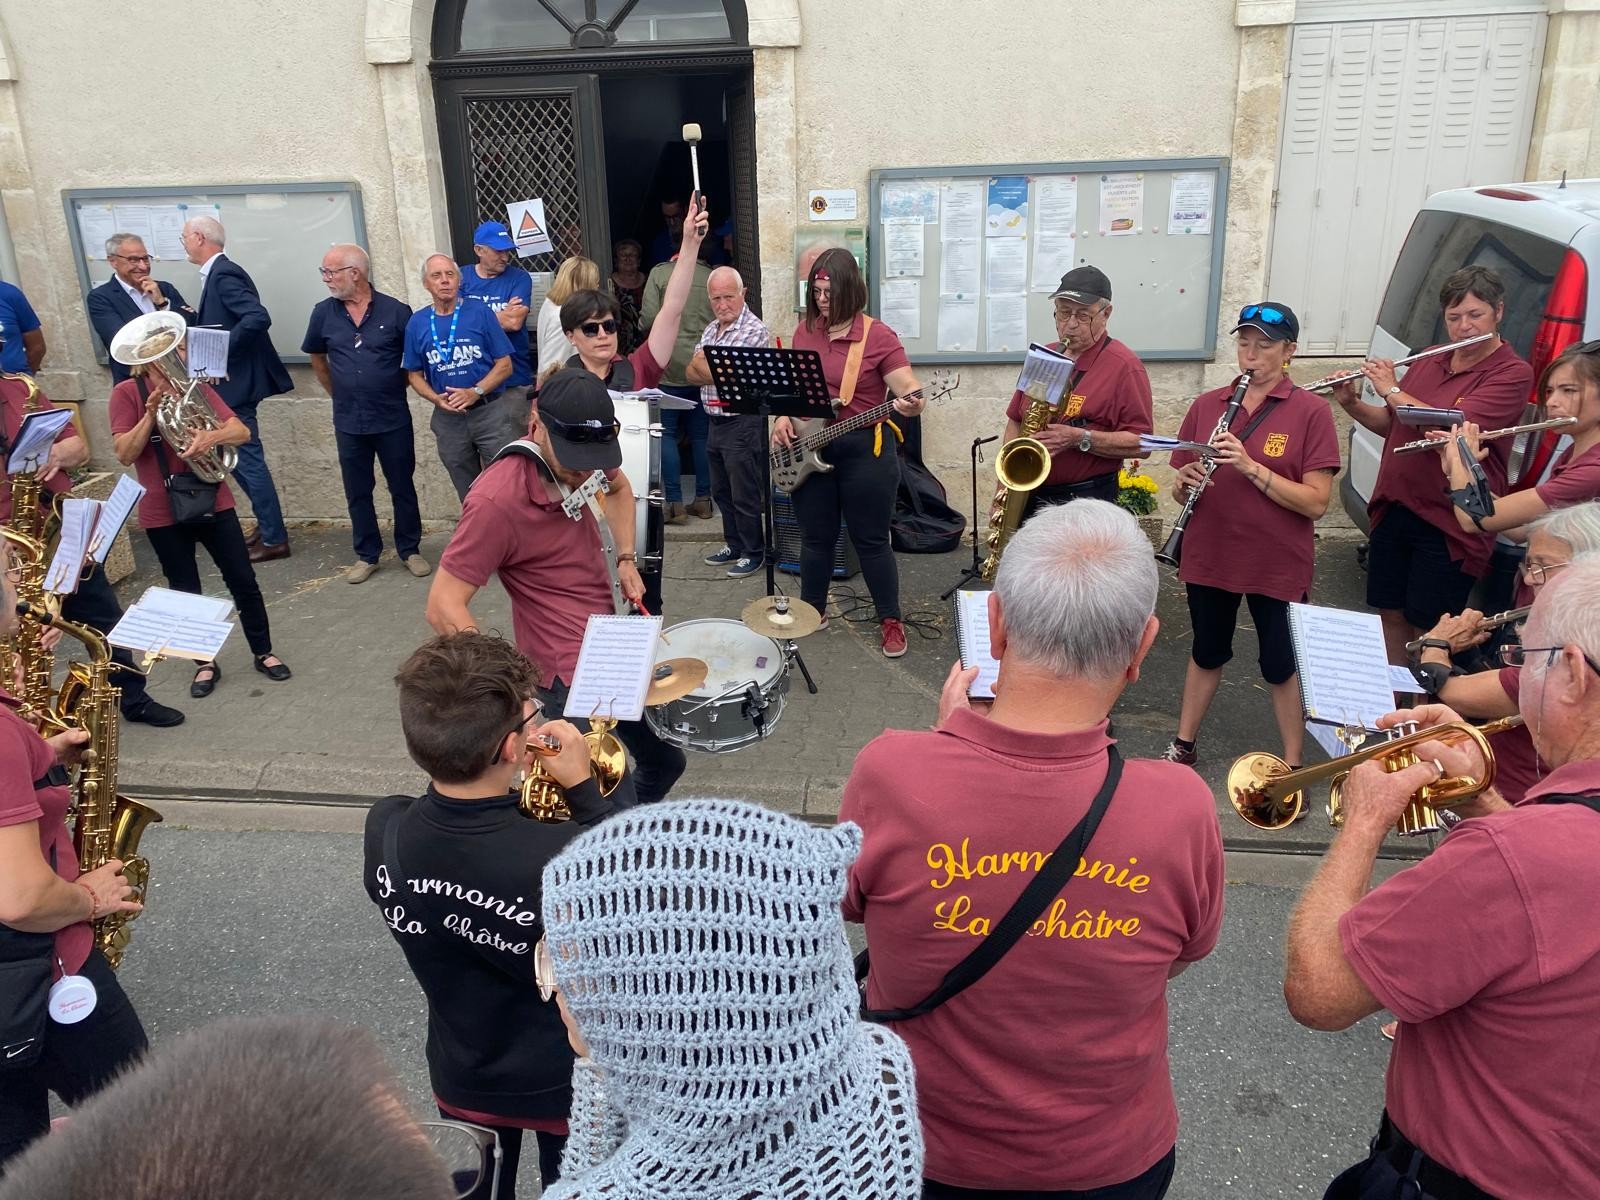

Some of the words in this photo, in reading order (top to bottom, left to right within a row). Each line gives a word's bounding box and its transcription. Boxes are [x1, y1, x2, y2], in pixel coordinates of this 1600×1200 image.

[453, 345, 482, 361] ANS
[384, 905, 427, 935] La
[933, 895, 991, 936] La
